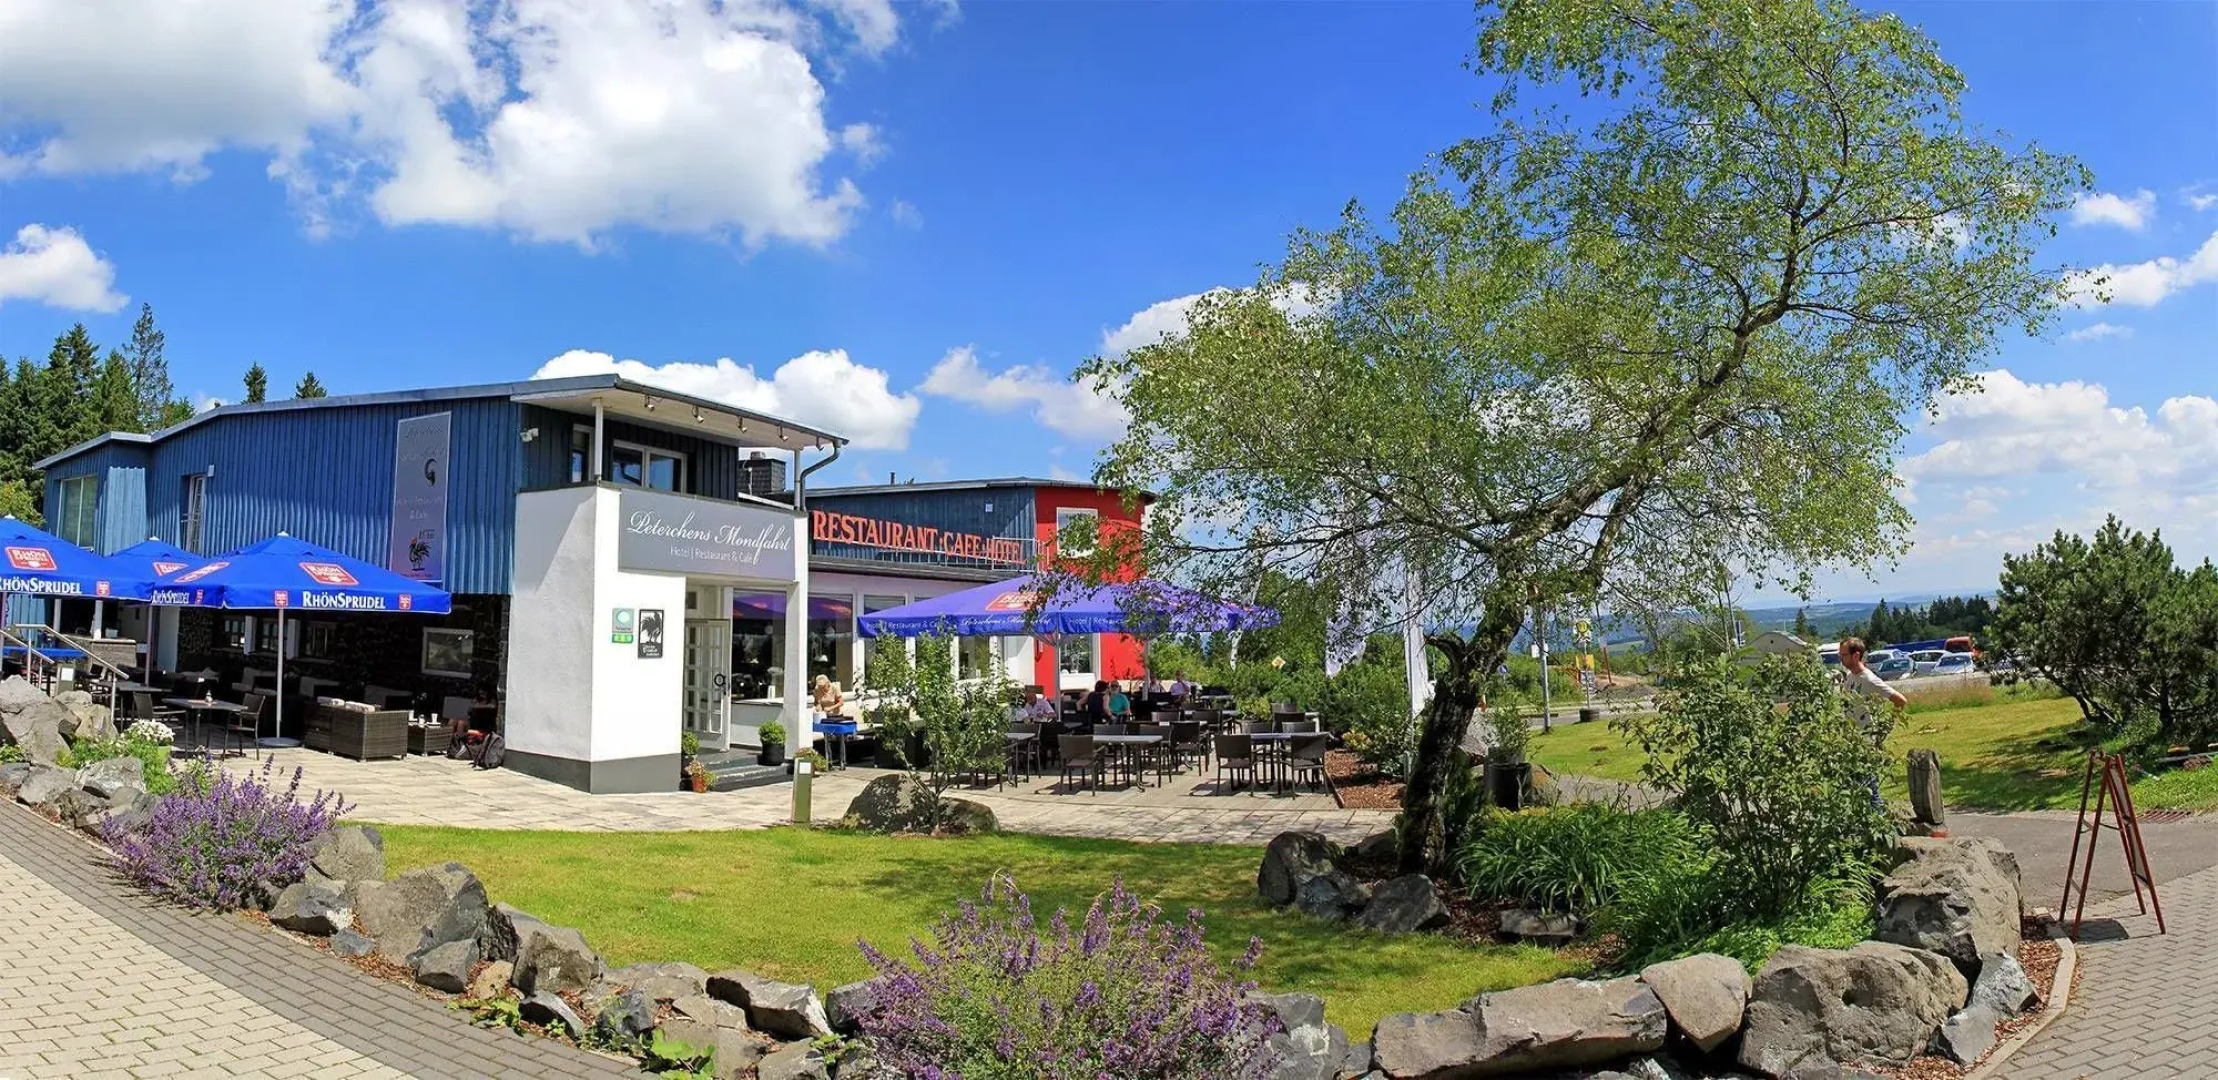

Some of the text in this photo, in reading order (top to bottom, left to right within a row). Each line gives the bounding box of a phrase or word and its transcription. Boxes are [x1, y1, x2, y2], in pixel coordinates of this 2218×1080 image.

[627, 511, 791, 565] Peterchens Mondfahrt
[695, 548, 731, 560] Restaurant
[813, 510, 1026, 565] RESTAURANT CAFE HOTEL
[0, 576, 82, 594] HÖNSPRUDEL
